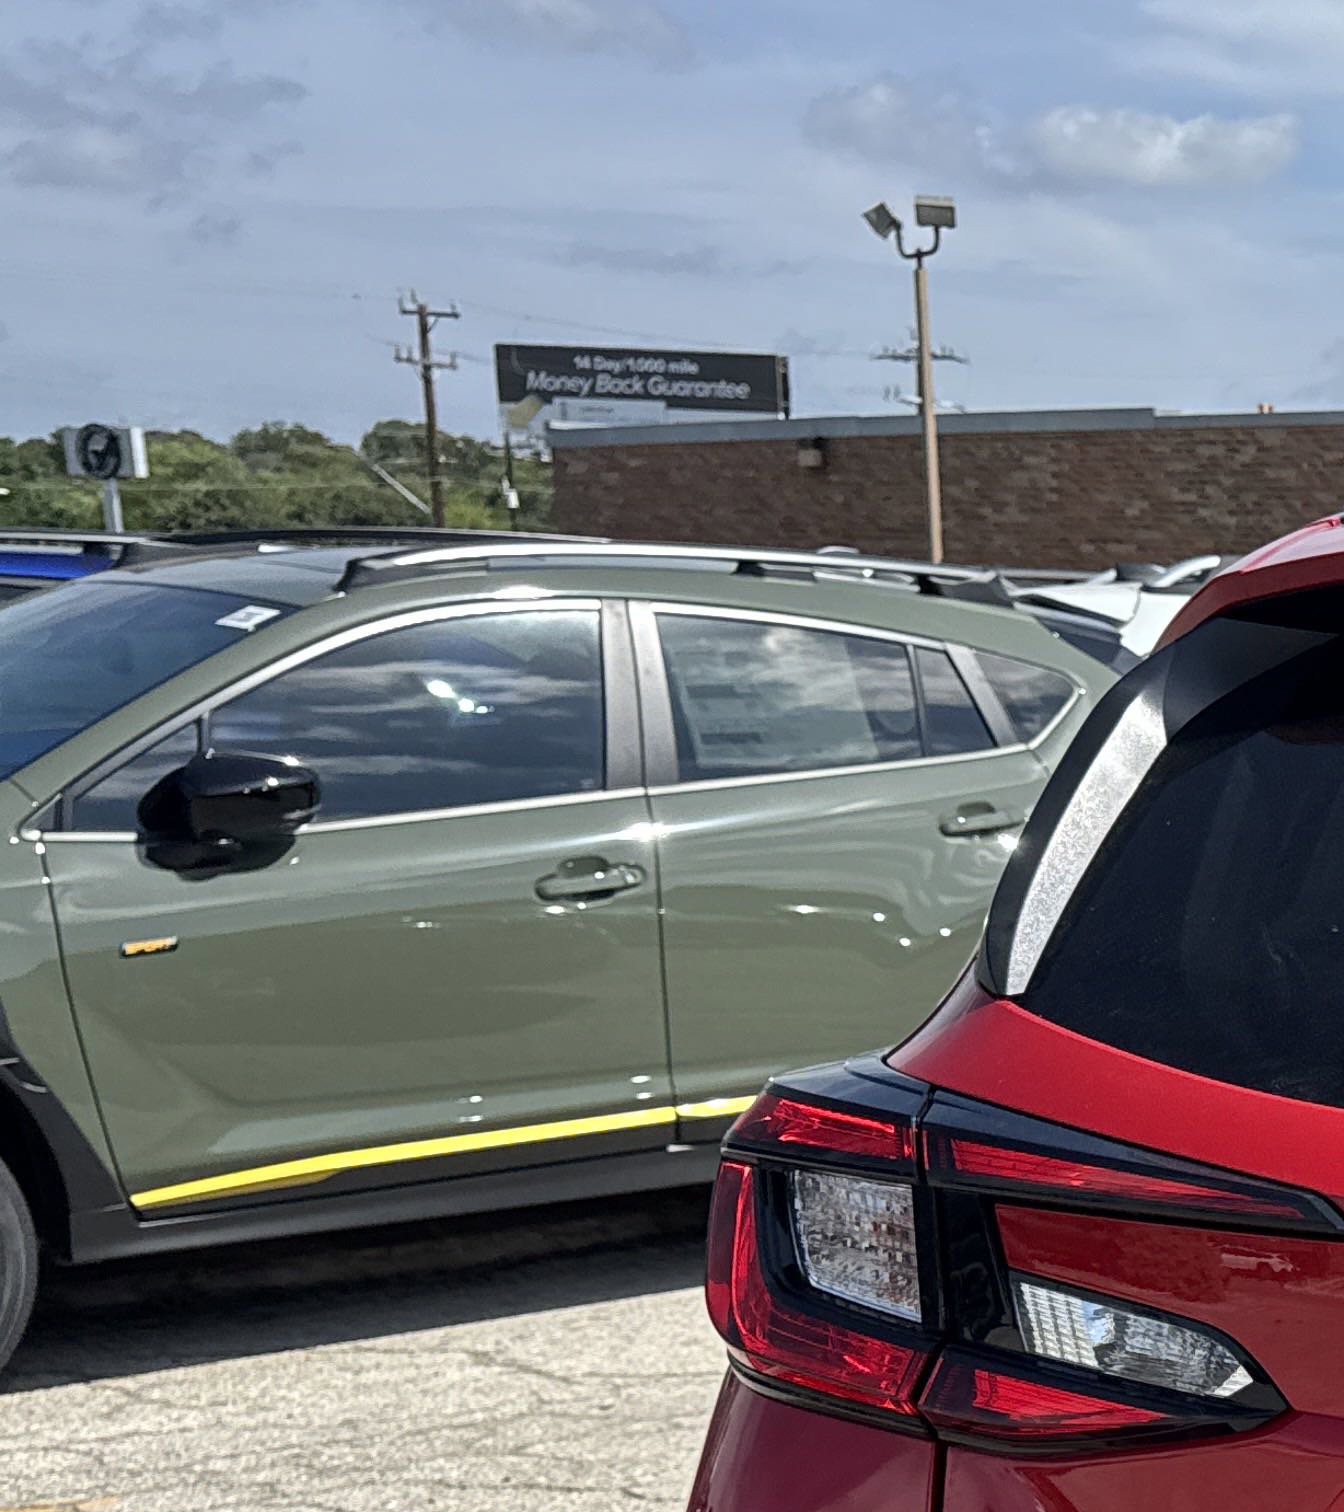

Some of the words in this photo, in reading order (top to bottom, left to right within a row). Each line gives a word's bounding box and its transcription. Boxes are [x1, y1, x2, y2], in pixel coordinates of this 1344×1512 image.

[526, 370, 594, 396] Money
[595, 373, 644, 396] Back
[647, 375, 751, 400] Guarantee
